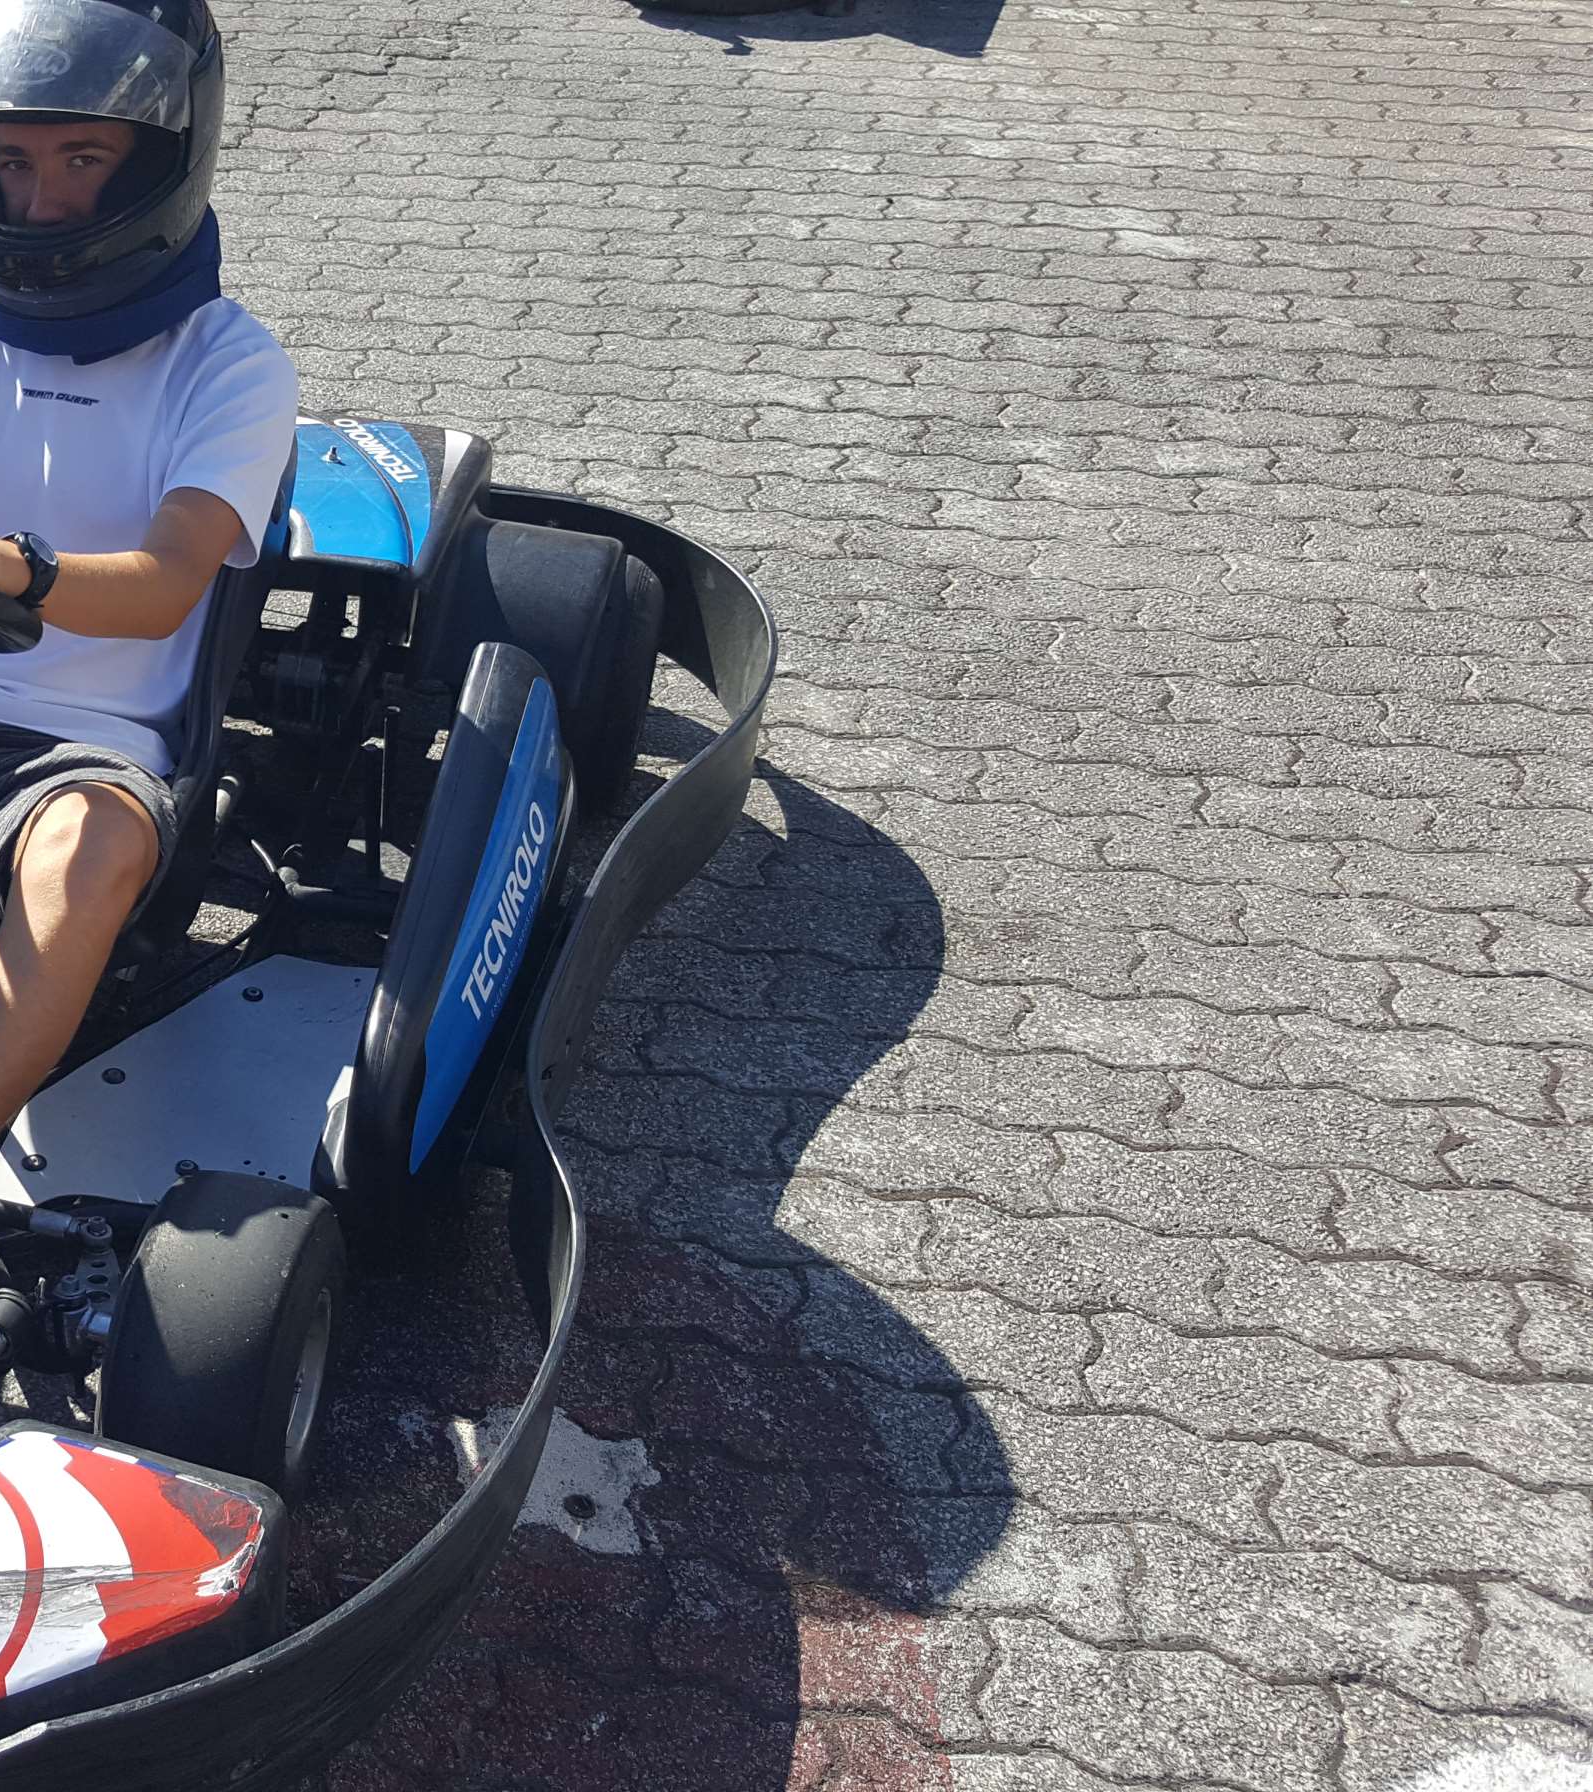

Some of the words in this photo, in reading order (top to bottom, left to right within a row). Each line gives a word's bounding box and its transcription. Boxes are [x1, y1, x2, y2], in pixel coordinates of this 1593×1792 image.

[22, 388, 54, 400] TEAM
[56, 393, 100, 406] QUEST
[333, 418, 419, 483] TECNIROLO
[461, 801, 545, 1021] TECNIROLO
